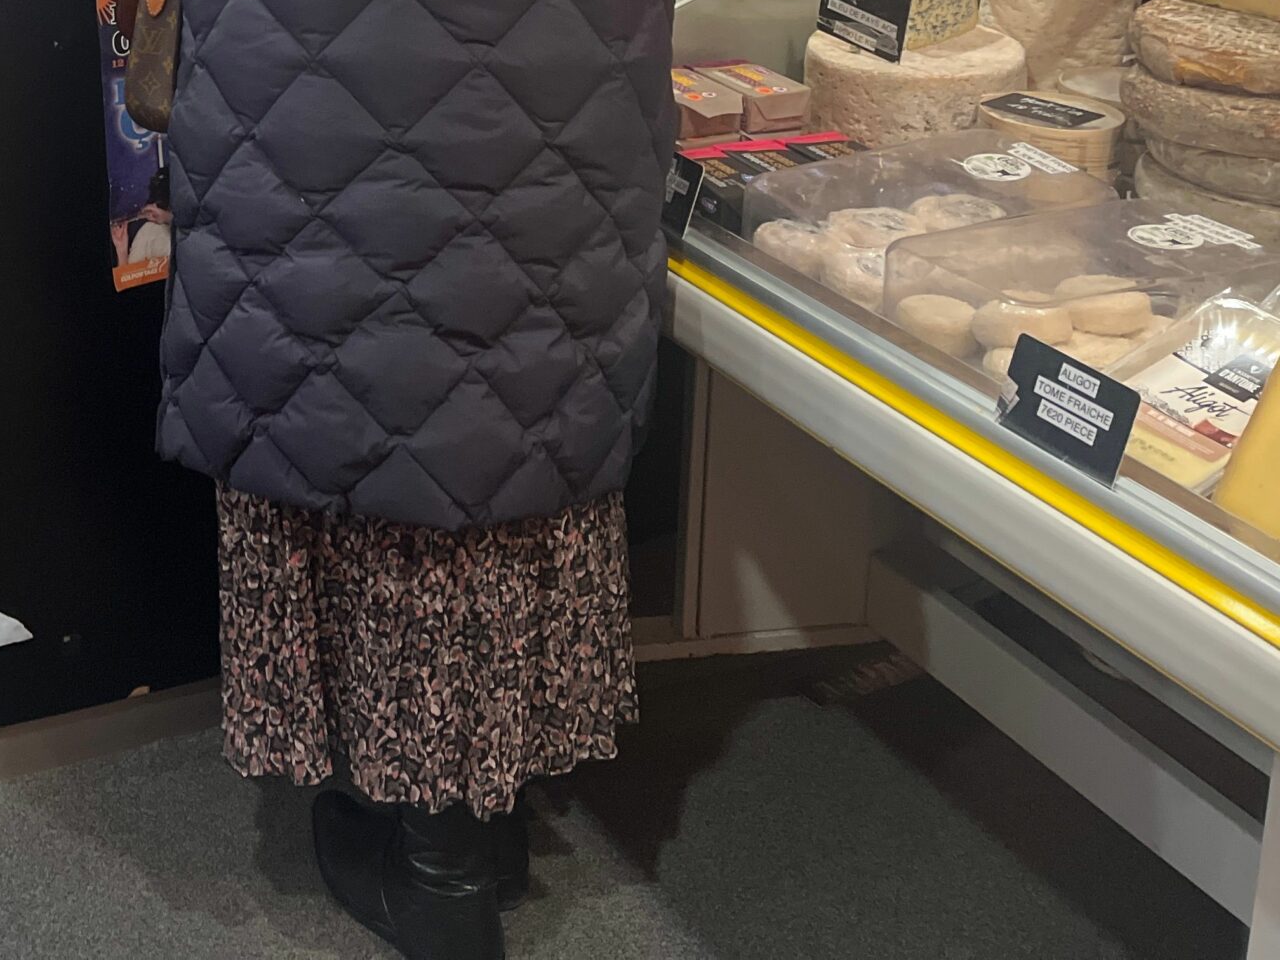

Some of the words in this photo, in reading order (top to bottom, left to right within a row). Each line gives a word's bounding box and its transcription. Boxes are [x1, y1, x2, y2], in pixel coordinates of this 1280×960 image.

[1061, 368, 1098, 392] ALIGOT
[1038, 380, 1067, 403] TOME
[1066, 395, 1112, 426] FRAICHE
[1160, 386, 1250, 418] Aligot
[1040, 403, 1064, 424] 7€20
[1064, 417, 1095, 441] PIECE
